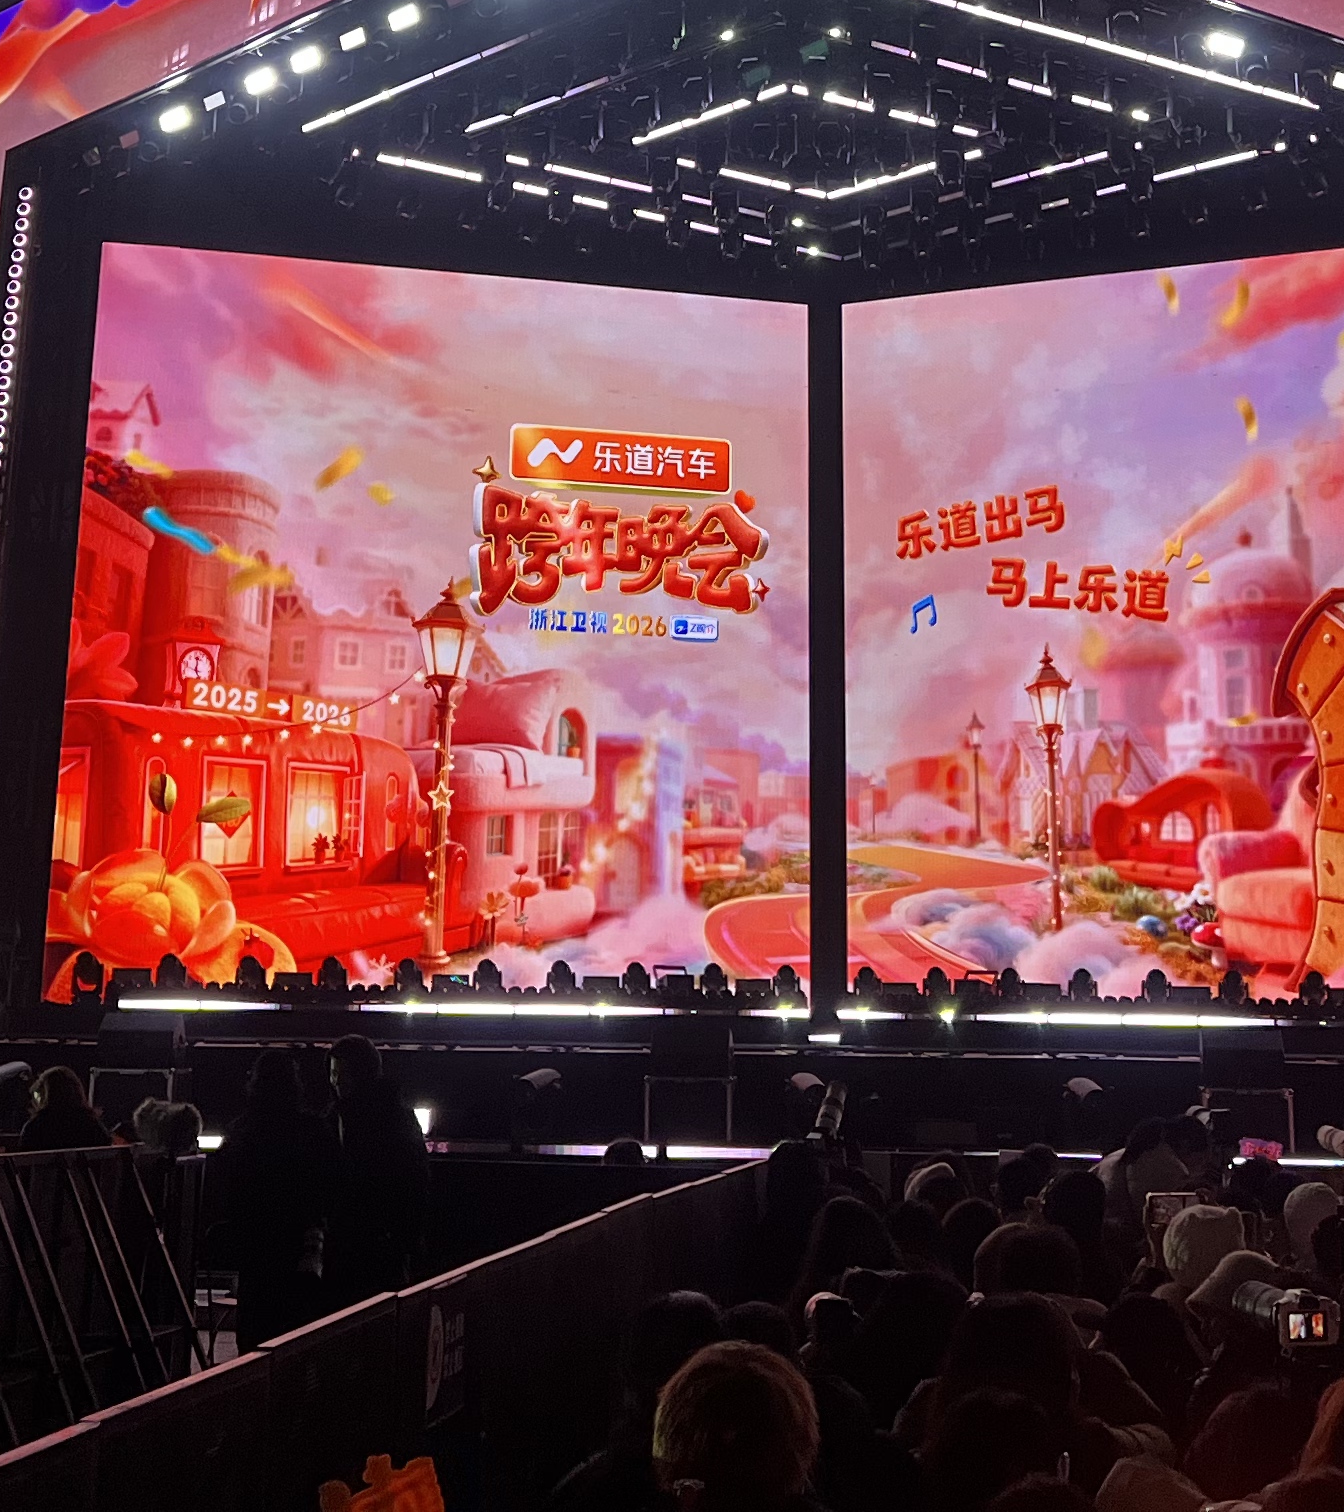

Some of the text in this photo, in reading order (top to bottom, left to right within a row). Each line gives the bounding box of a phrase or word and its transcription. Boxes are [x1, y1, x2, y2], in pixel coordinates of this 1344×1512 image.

[593, 441, 717, 480] 乐道汽车
[470, 483, 769, 617] 跨年晚会
[896, 484, 1066, 560] 乐道出马
[986, 556, 1169, 623] 马上乐道
[528, 608, 667, 637] 浙江卫视 2026
[192, 682, 352, 727] 2025 2026
